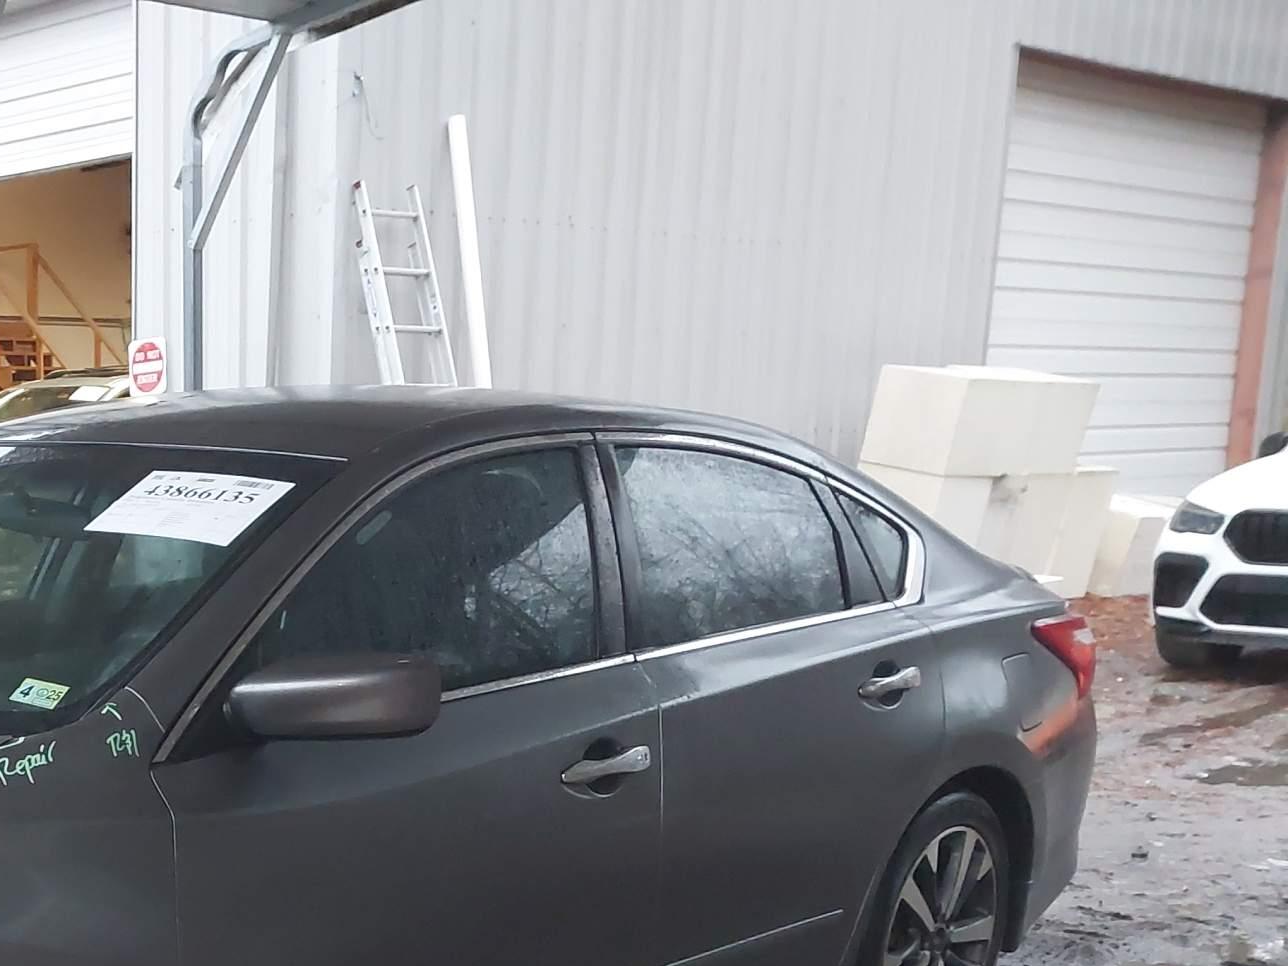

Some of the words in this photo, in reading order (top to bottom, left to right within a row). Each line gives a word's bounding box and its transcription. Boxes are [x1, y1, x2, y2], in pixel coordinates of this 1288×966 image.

[135, 352, 145, 361] DO
[146, 349, 160, 360] NOT
[143, 484, 261, 505] 43866135
[19, 685, 33, 698] 4
[47, 689, 63, 702] 25
